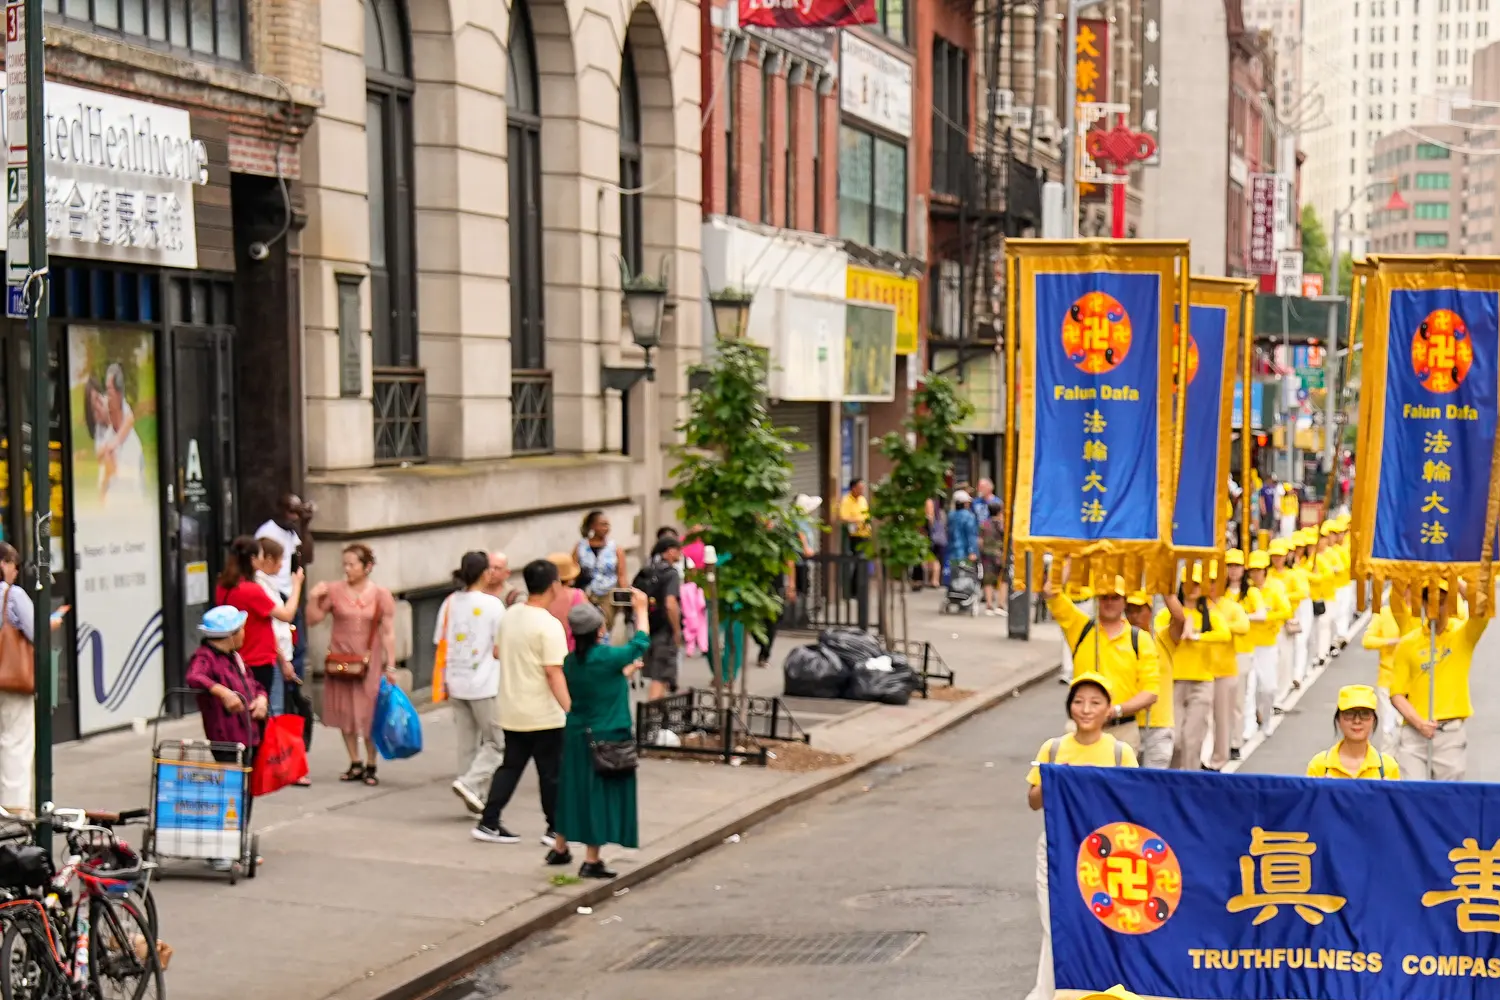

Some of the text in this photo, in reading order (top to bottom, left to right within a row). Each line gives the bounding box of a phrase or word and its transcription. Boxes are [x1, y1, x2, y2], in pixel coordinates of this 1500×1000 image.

[1053, 384, 1140, 402] Falun Dafa
[1402, 403, 1479, 421] Falun Dafa
[1080, 408, 1108, 523] 法輪大法
[1420, 429, 1452, 546] 法輪大法
[1188, 947, 1383, 974] TRUTHFULNESS
